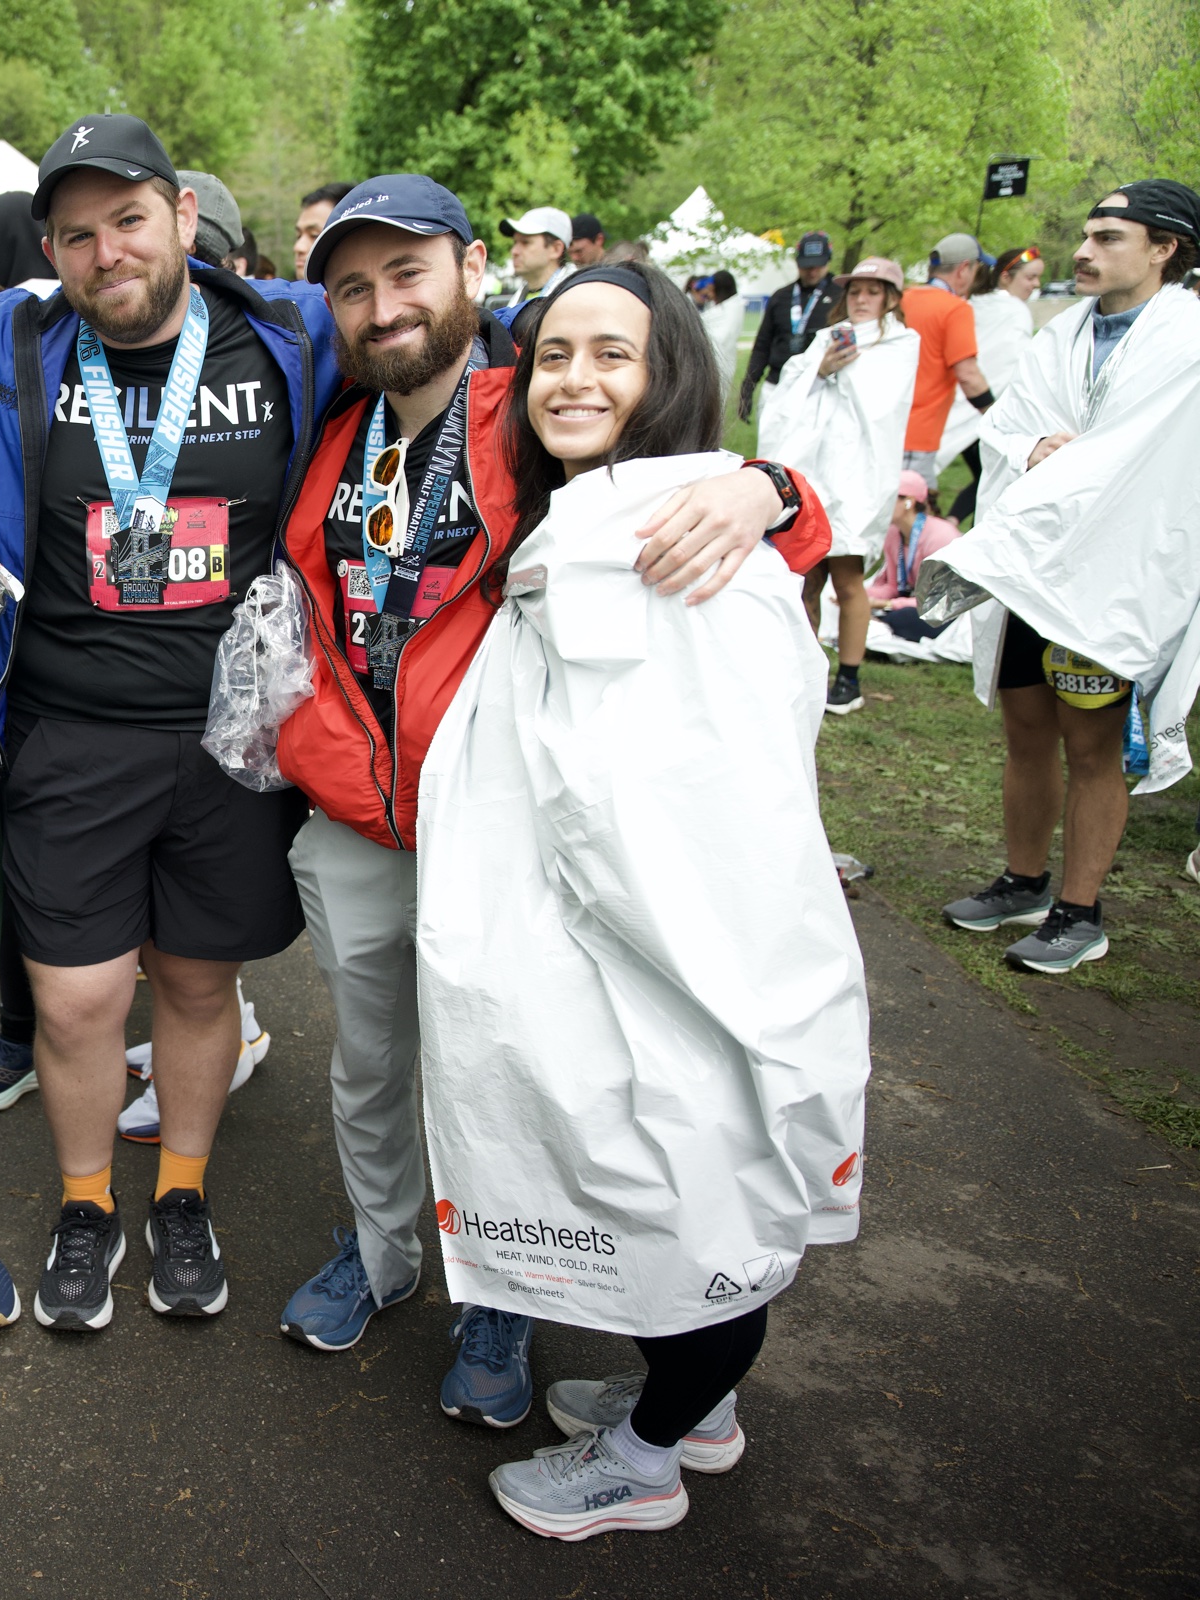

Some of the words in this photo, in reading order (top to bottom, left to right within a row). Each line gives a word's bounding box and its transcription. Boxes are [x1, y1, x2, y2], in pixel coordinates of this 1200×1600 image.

[340, 198, 373, 219] dialed
[376, 194, 390, 203] in
[157, 315, 206, 445] FINISHER
[83, 365, 135, 481] FINISHER
[199, 431, 233, 444] NEXT
[234, 428, 262, 441] STEP
[421, 470, 436, 497] HALF
[404, 494, 429, 551] MARATHON
[412, 474, 450, 554] EXPERIENCE
[446, 526, 477, 540] NEXT
[94, 560, 104, 579] 2
[212, 556, 223, 574] B
[122, 583, 160, 592] BROOKLYN
[1055, 672, 1115, 694] 38132
[462, 1209, 616, 1256] Heatsheets
[495, 1249, 525, 1263] HEAT,
[526, 1253, 557, 1267] WIND,
[558, 1258, 591, 1272] COLD,
[592, 1263, 618, 1276] RAIN
[456, 1257, 479, 1269] Weather
[483, 1264, 499, 1274] Silver
[500, 1266, 514, 1277] Side
[524, 1270, 545, 1280] Warm
[545, 1273, 574, 1285] Weather
[577, 1278, 596, 1289] Silver
[596, 1281, 613, 1292] Side
[612, 1284, 626, 1294] Out
[716, 1281, 726, 1292] 4
[507, 1280, 566, 1300] @heatsheets
[710, 1295, 734, 1305] LDPE
[584, 1485, 633, 1511] HOKA
